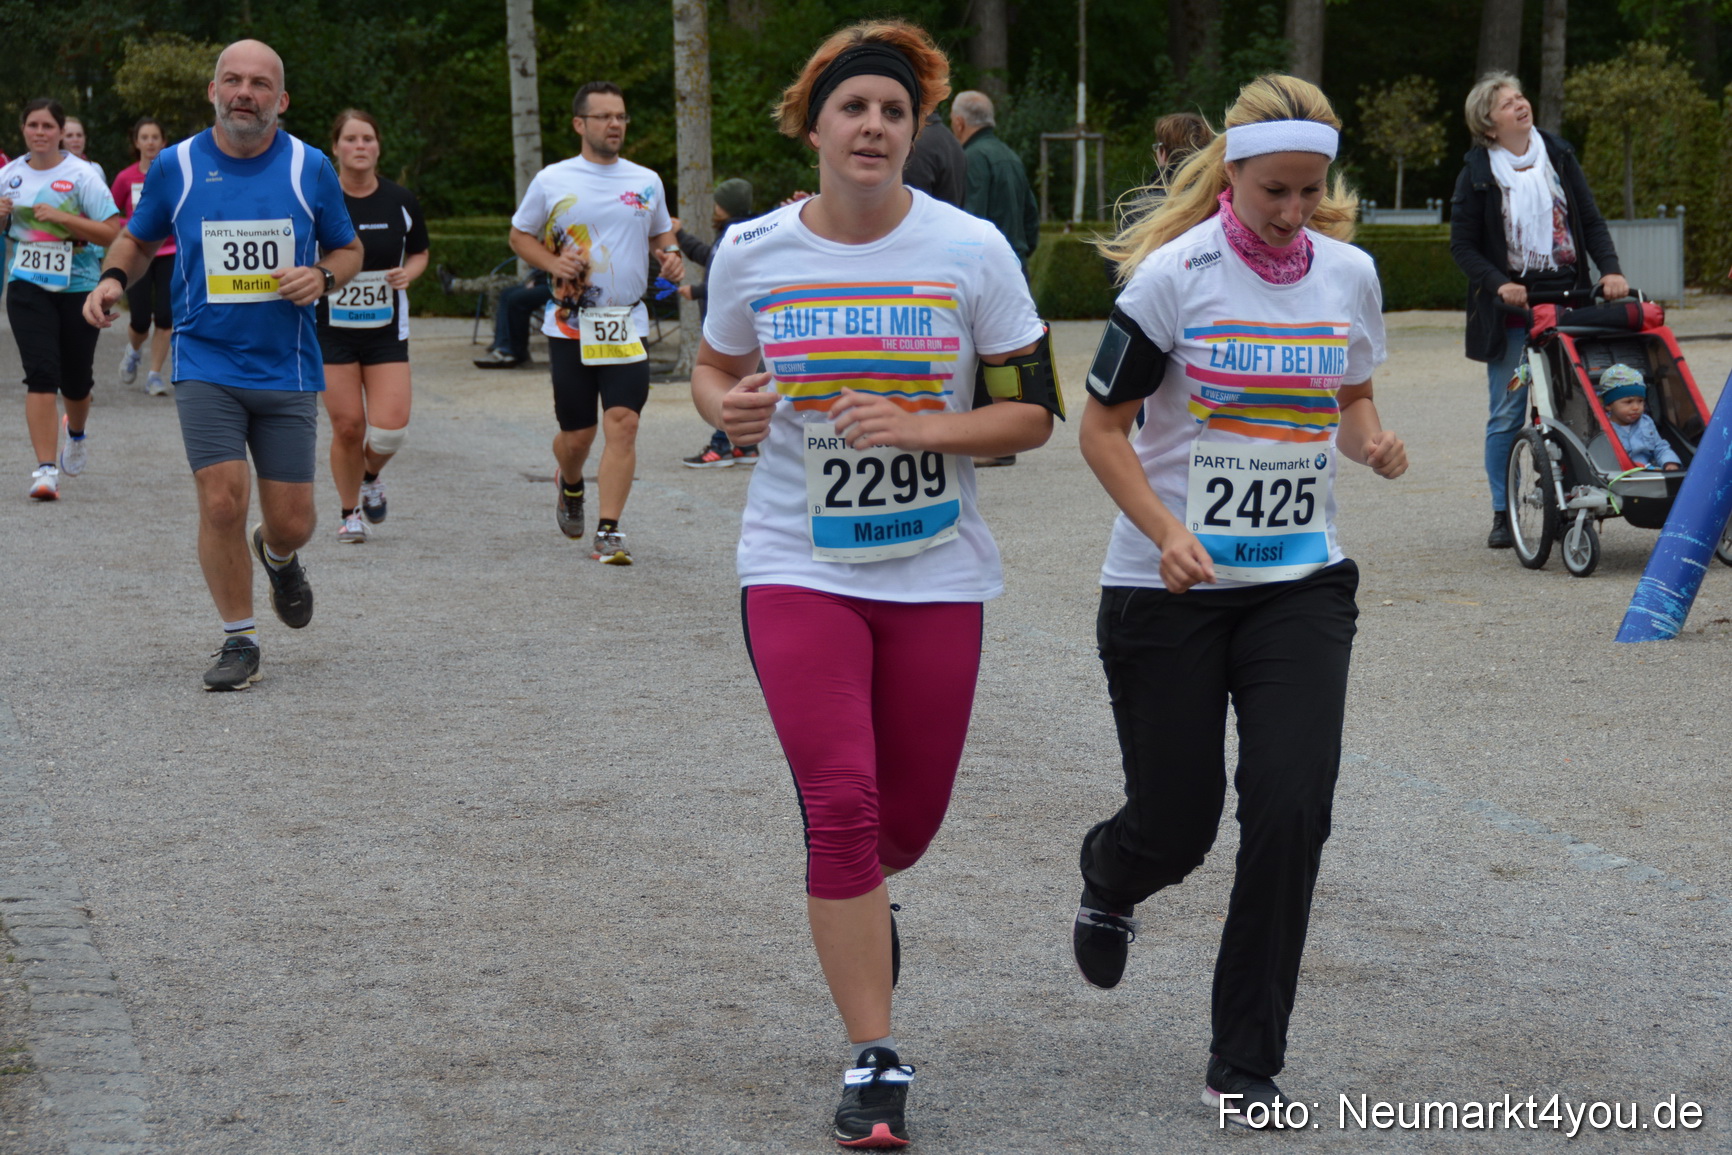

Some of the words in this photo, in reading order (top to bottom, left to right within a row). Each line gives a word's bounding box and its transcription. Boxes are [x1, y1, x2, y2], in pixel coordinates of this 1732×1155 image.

[204, 229, 235, 238] PARTL
[236, 228, 280, 237] Neumarkt
[742, 221, 780, 242] Brillux
[20, 249, 66, 272] 2813
[222, 240, 279, 271] 380
[1190, 250, 1222, 267] Brillux
[232, 279, 271, 291] Martin
[335, 284, 388, 307] 2254
[348, 311, 376, 320] Carina
[772, 305, 839, 340] LÄUFT
[845, 306, 882, 335] BEI
[889, 306, 933, 337] MIR
[594, 320, 628, 342] 528
[881, 338, 898, 350] THE
[899, 338, 926, 350] COLOR
[926, 339, 942, 350] RUN
[1209, 338, 1275, 373] LÄUFT
[1281, 346, 1313, 374] BEI
[1318, 346, 1345, 375] MIR
[1309, 377, 1323, 388] THE
[1205, 389, 1241, 402] #WESHINE
[808, 437, 853, 450] PART
[1194, 455, 1245, 470] PARTL
[1249, 457, 1310, 471] Neumarkt
[823, 451, 947, 508] 2299
[1203, 477, 1317, 528] 2425
[854, 519, 923, 543] Marina
[1235, 541, 1284, 562] Krissi
